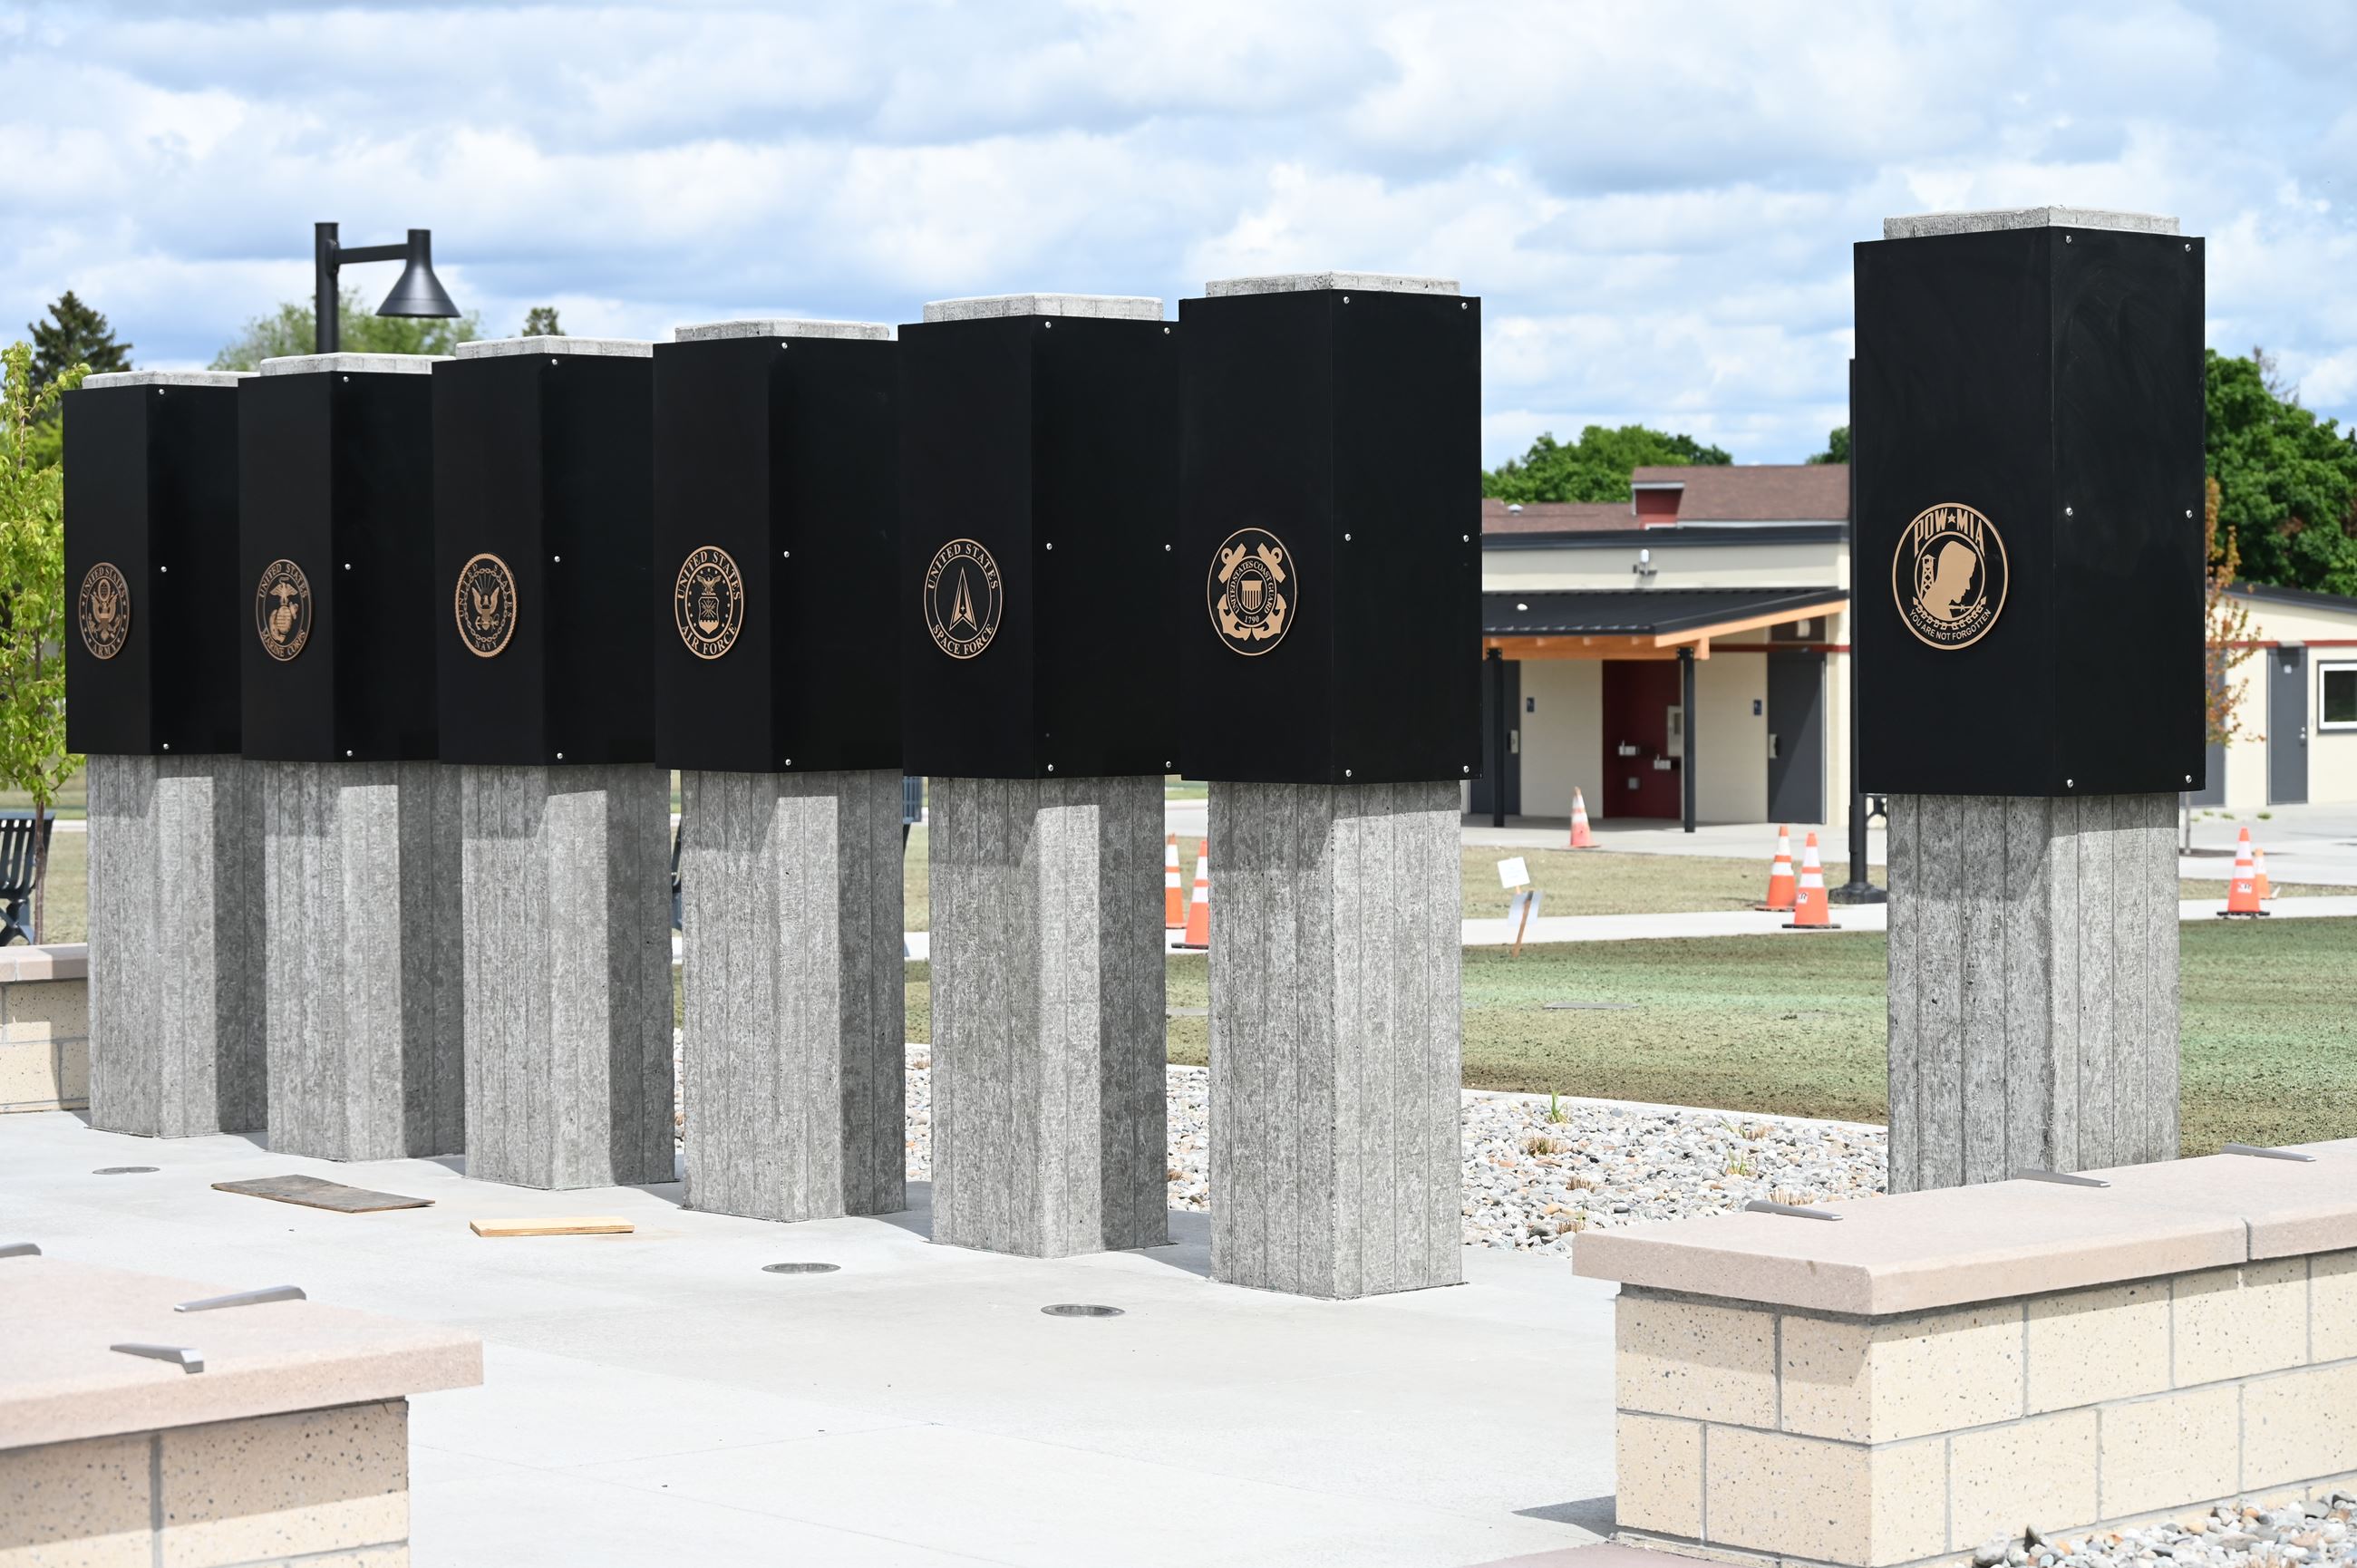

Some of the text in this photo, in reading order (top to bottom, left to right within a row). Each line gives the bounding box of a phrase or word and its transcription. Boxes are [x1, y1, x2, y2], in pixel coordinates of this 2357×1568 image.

[1914, 508, 1985, 558] POW MIA
[82, 566, 103, 598] UNITED
[677, 551, 741, 600] UNITED STATES
[927, 544, 998, 589] UNITED STATES
[459, 563, 513, 617] UNITED STATES
[1230, 560, 1275, 615] UNITED STATES COAST GUARD
[1244, 615, 1260, 624] 1790
[1909, 608, 1992, 641] YOU ARE NOT FORGOTTEN
[92, 644, 117, 655] ARMY
[475, 641, 497, 651] NAVY
[681, 623, 737, 654] AIR FORCE
[933, 624, 994, 654] SPACE FORCE
